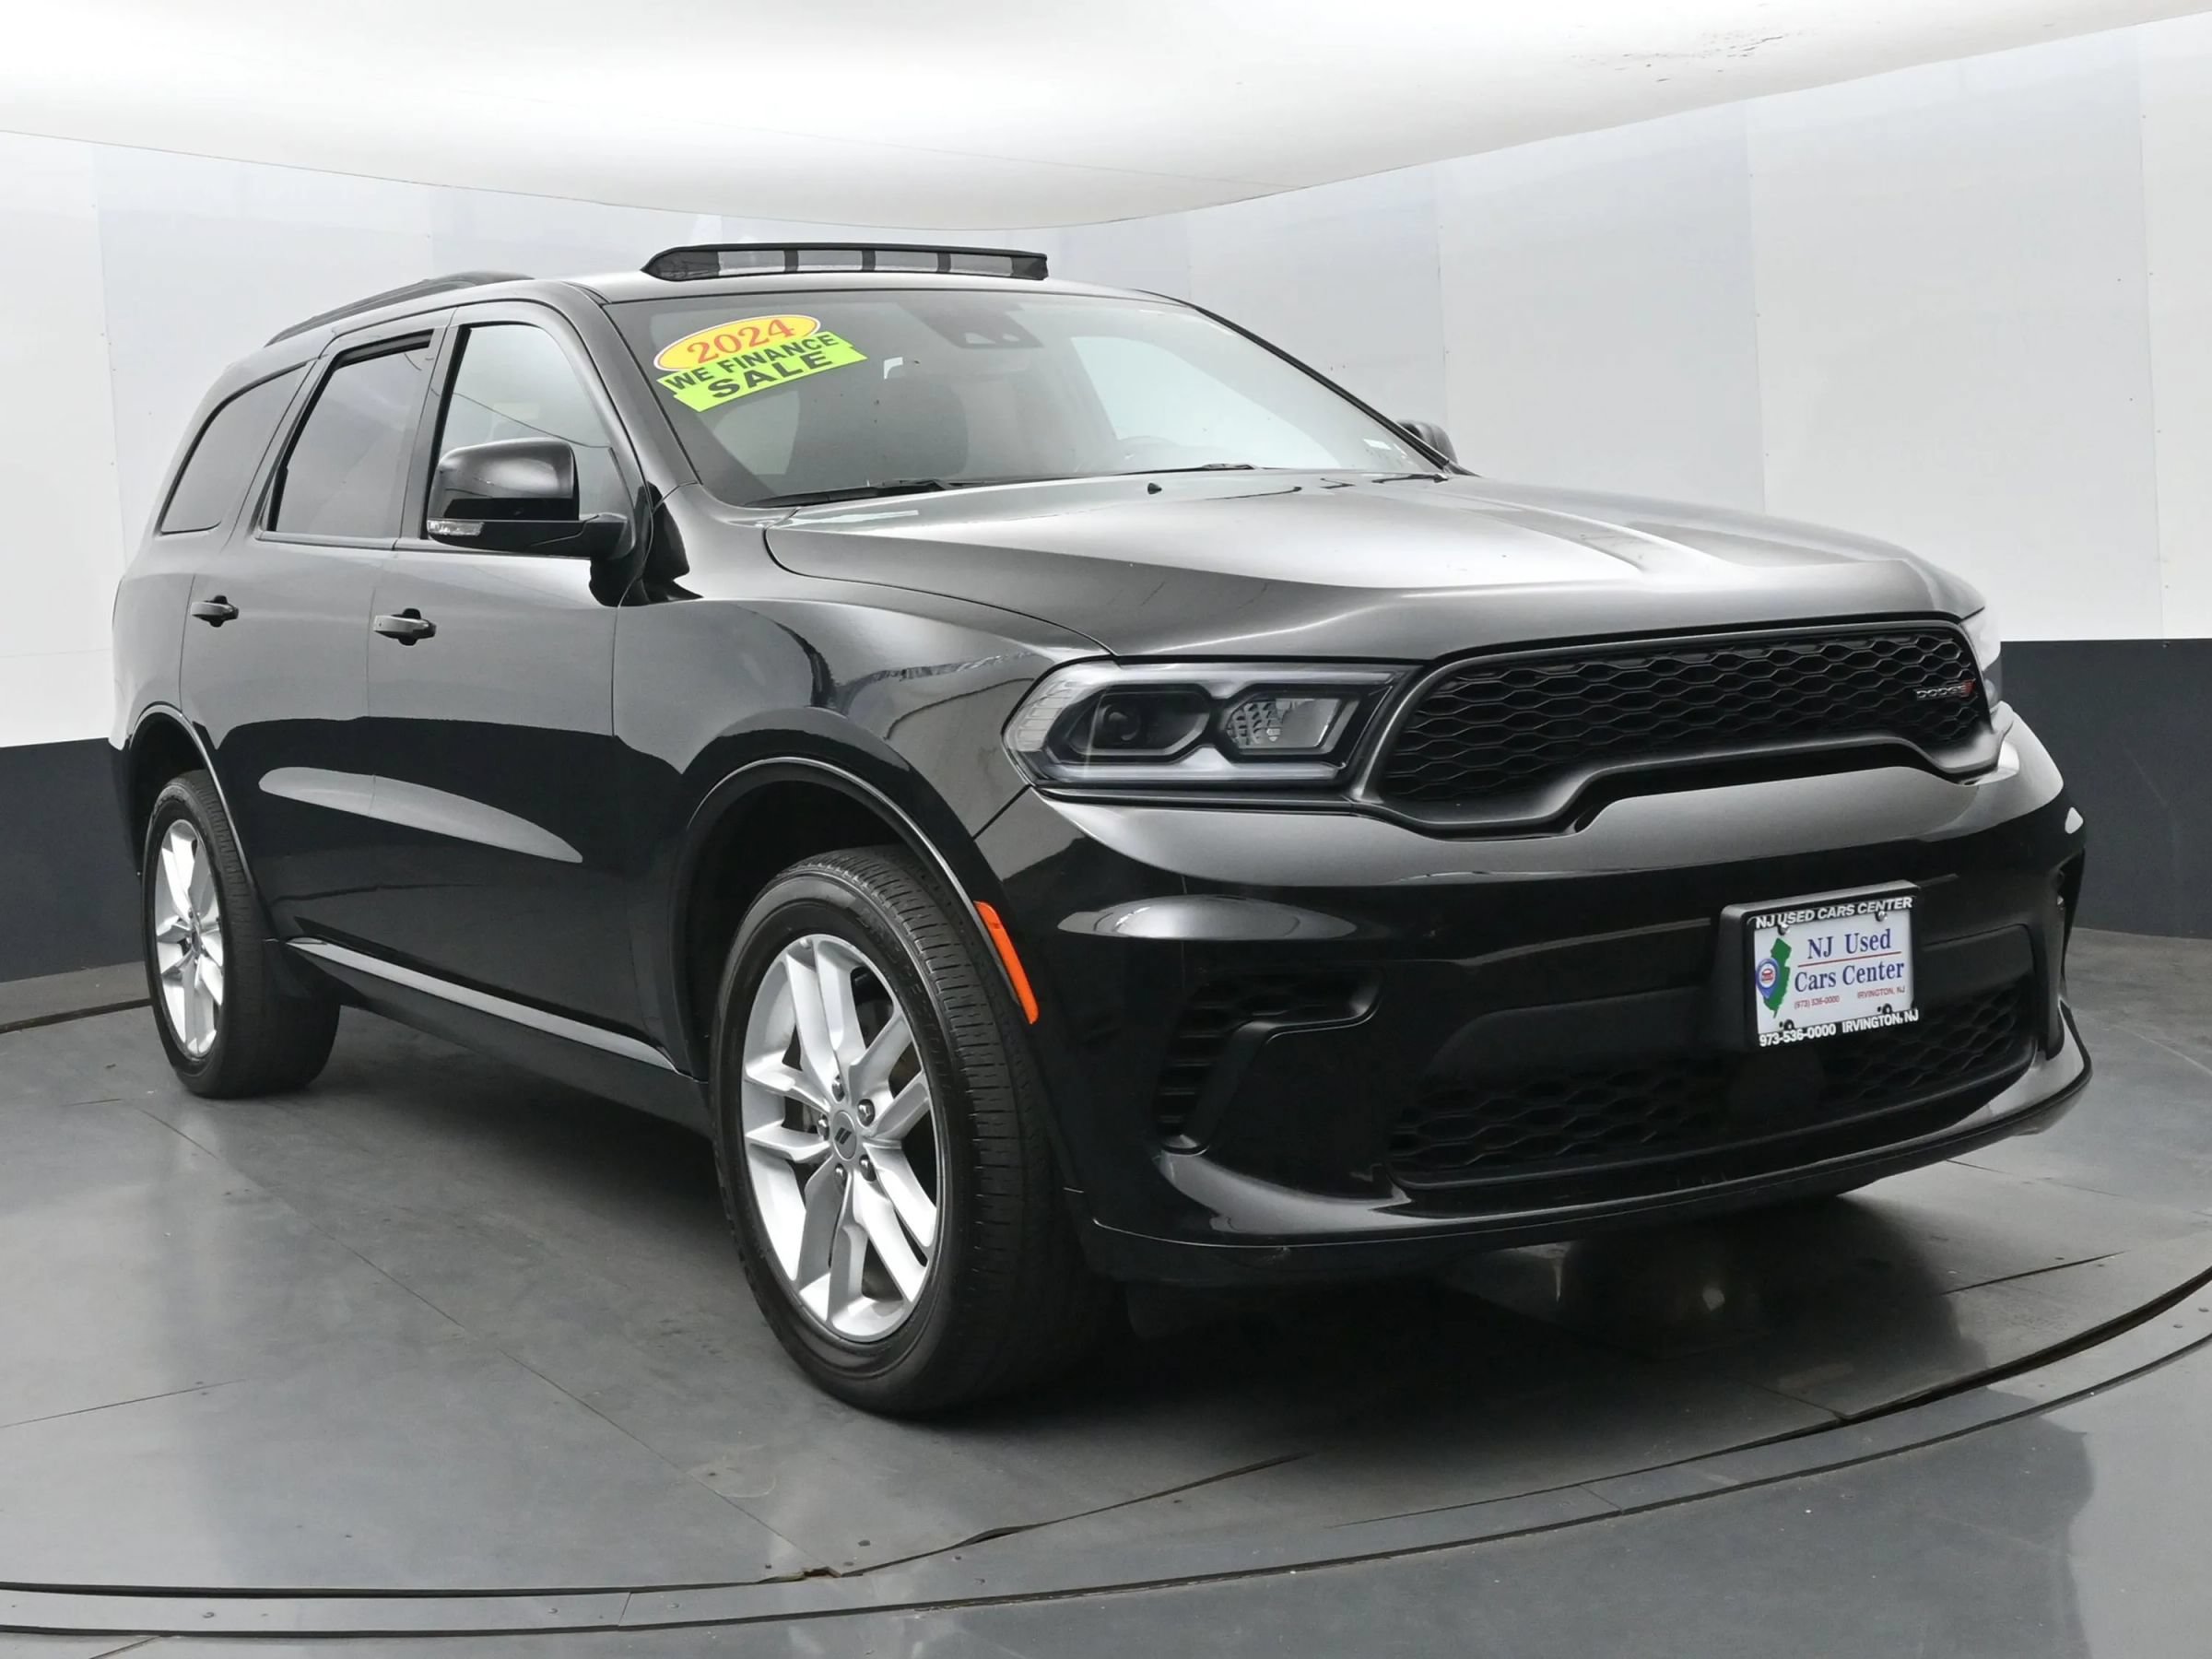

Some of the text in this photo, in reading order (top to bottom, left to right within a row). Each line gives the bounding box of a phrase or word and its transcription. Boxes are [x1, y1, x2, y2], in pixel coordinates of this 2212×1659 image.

[688, 319, 794, 364] 2024
[665, 335, 839, 390] WE FINANCE
[708, 351, 833, 398] SALE
[1755, 897, 1913, 929] NJ USED CARS CENTER
[1807, 928, 1891, 959] NJ Used
[1794, 962, 1905, 993] Cars Center
[1794, 999, 1810, 1009] (973)
[1896, 985, 1906, 994] NJ
[1759, 1023, 1837, 1047] 973-536-0000
[1904, 1008, 1919, 1022] NJ
